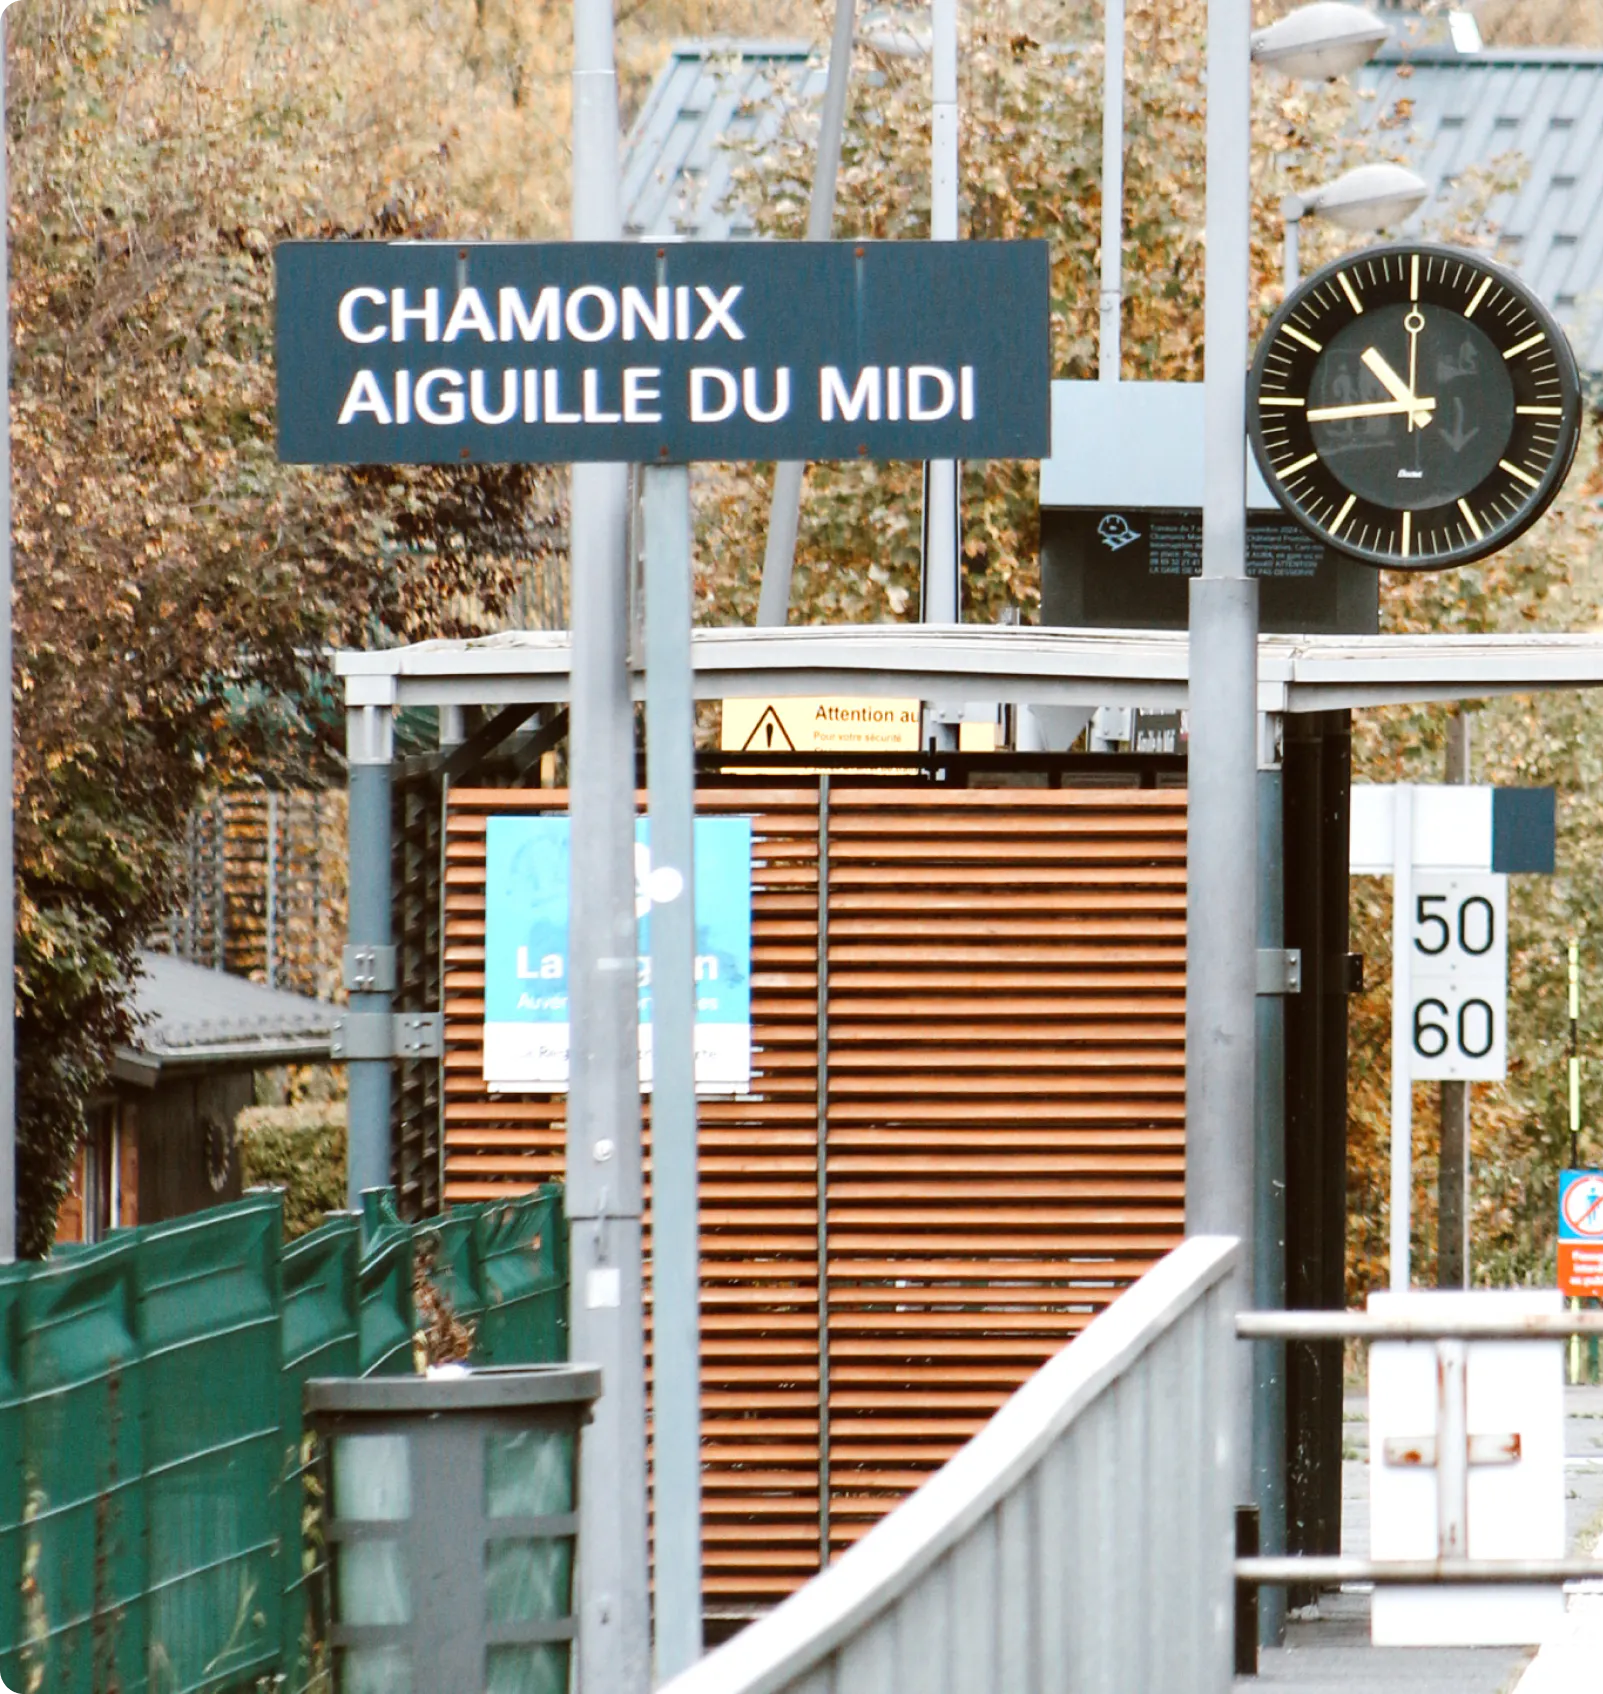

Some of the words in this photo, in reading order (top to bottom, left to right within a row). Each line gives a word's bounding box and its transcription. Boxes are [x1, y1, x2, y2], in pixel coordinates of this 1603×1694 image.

[338, 285, 745, 344] CHAMONIX
[338, 367, 662, 425] AIGUILLE
[690, 367, 790, 423] DU
[820, 365, 974, 421] MIDI
[815, 705, 894, 722] Attention
[1414, 894, 1495, 956] 50
[1412, 997, 1494, 1059] 60
